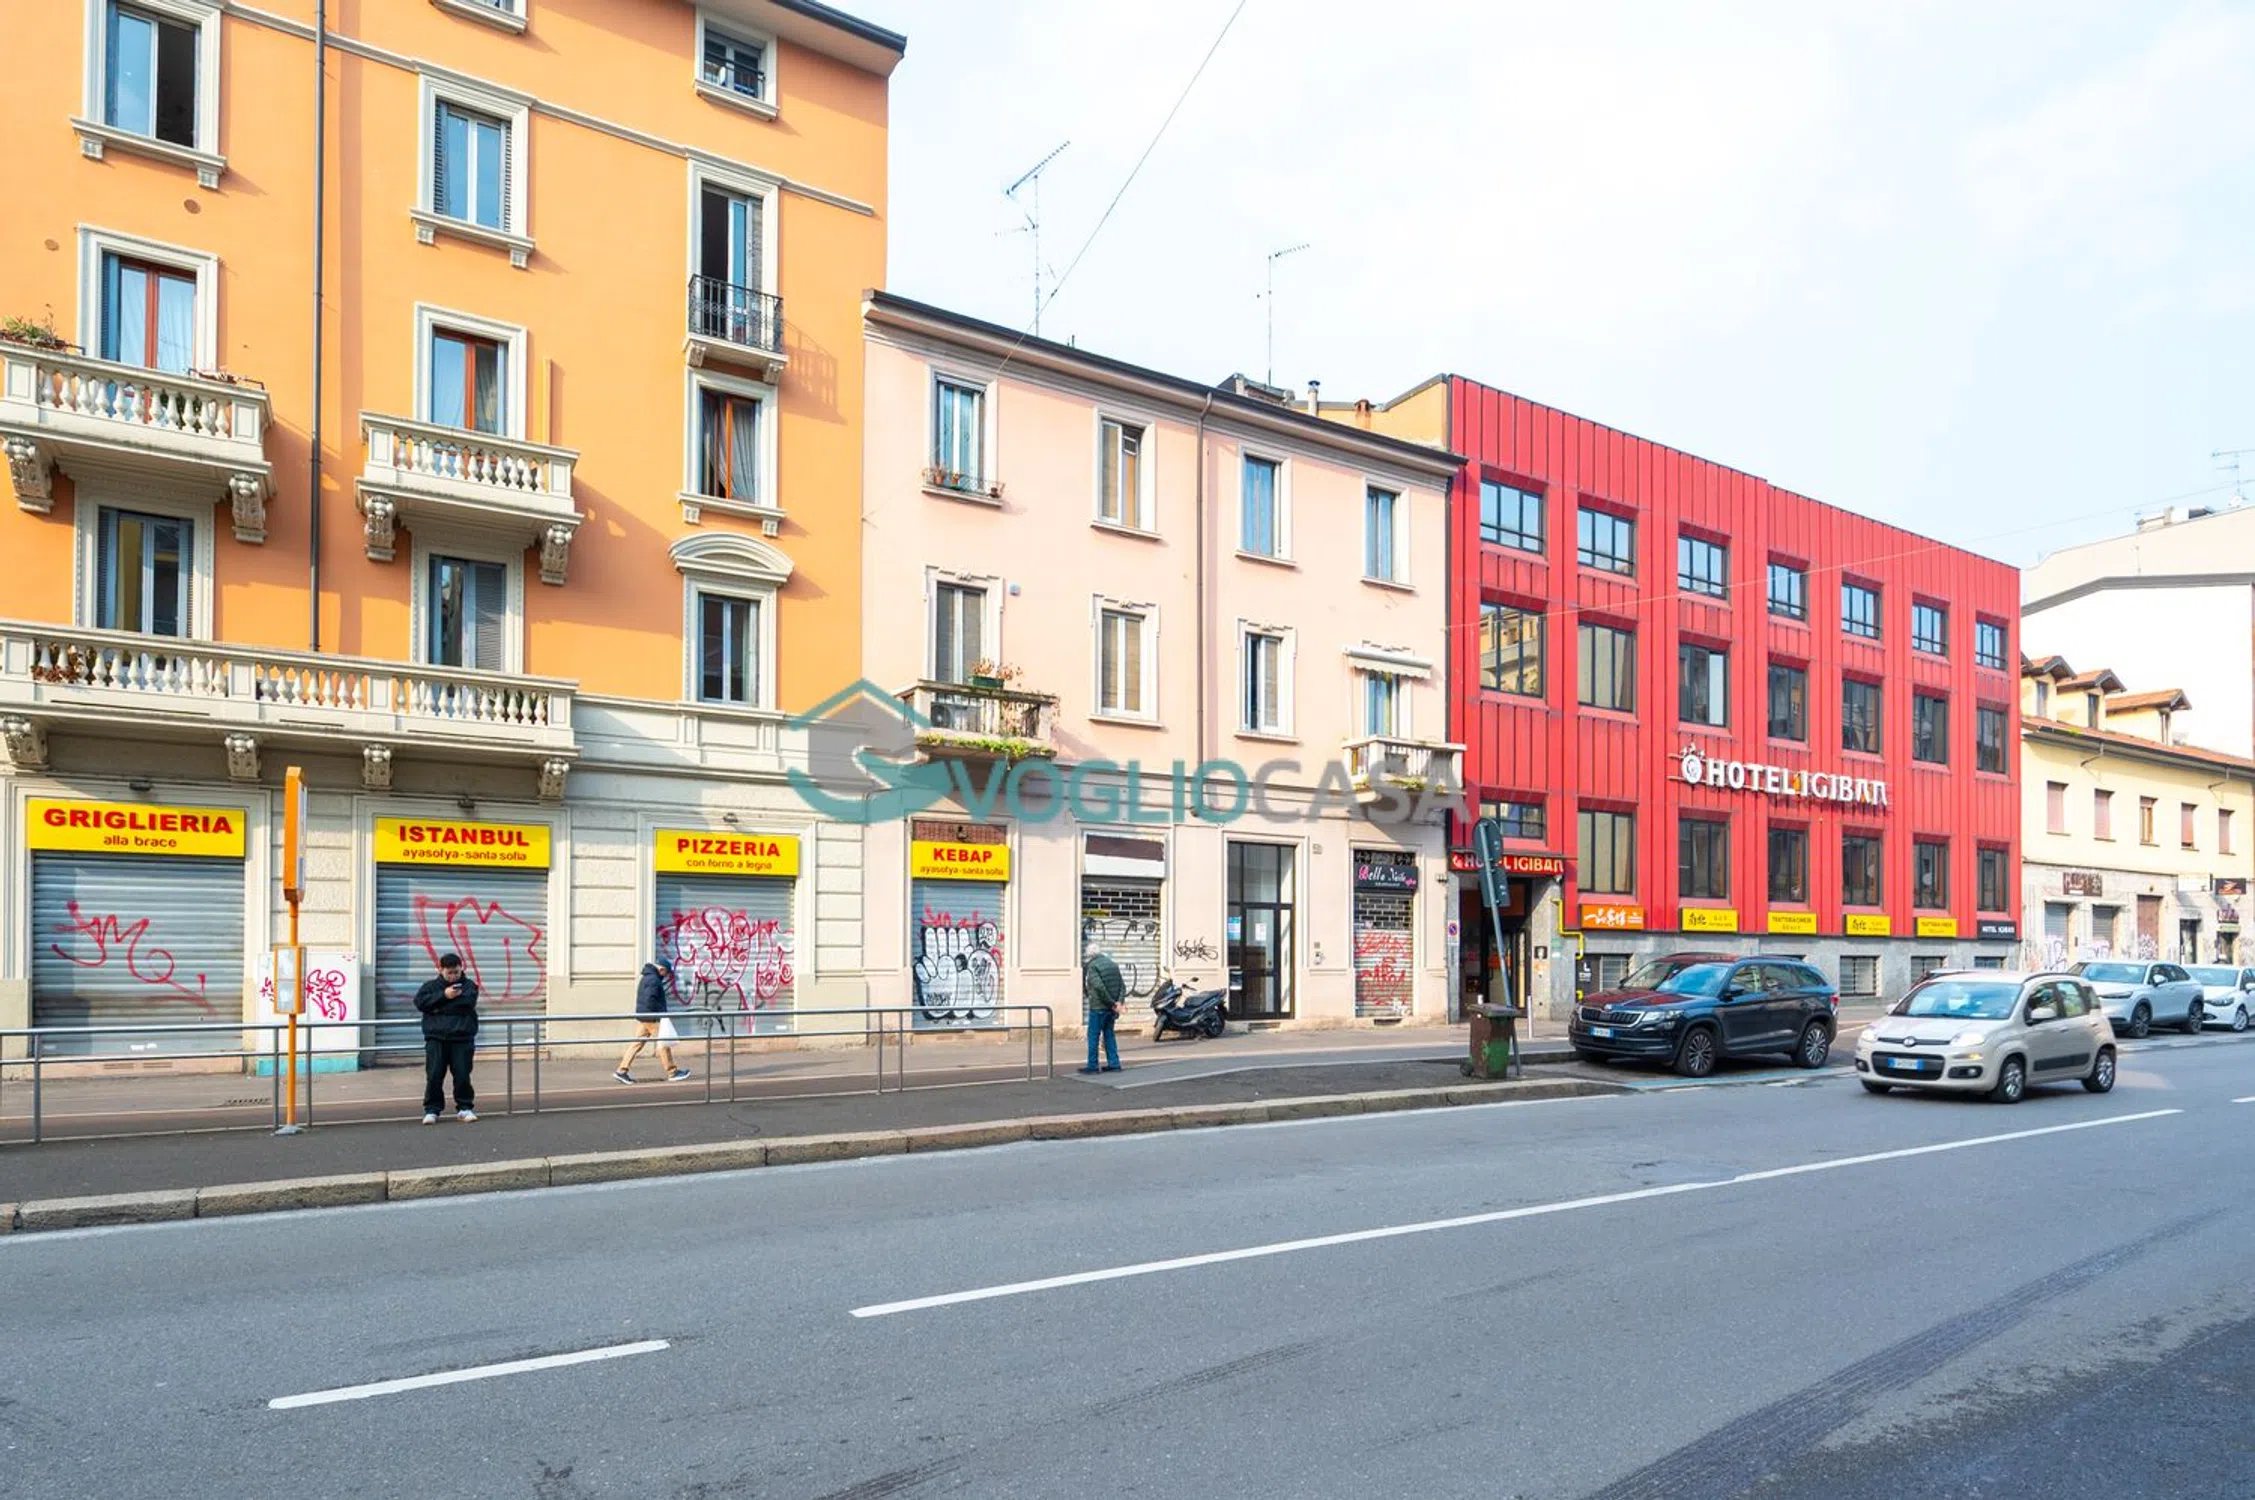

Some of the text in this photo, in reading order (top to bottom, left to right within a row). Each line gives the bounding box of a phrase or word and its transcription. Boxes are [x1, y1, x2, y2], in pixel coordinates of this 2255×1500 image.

[1708, 757, 1796, 795] HOTEL
[43, 808, 233, 834] GRIGLIERIA
[103, 835, 177, 848] alla brace
[399, 825, 530, 847] ISTANBUL
[677, 838, 781, 857] PIZZERIA
[933, 847, 992, 863] KEBAP
[499, 852, 527, 861] sofia
[686, 859, 772, 872] con forno a legna
